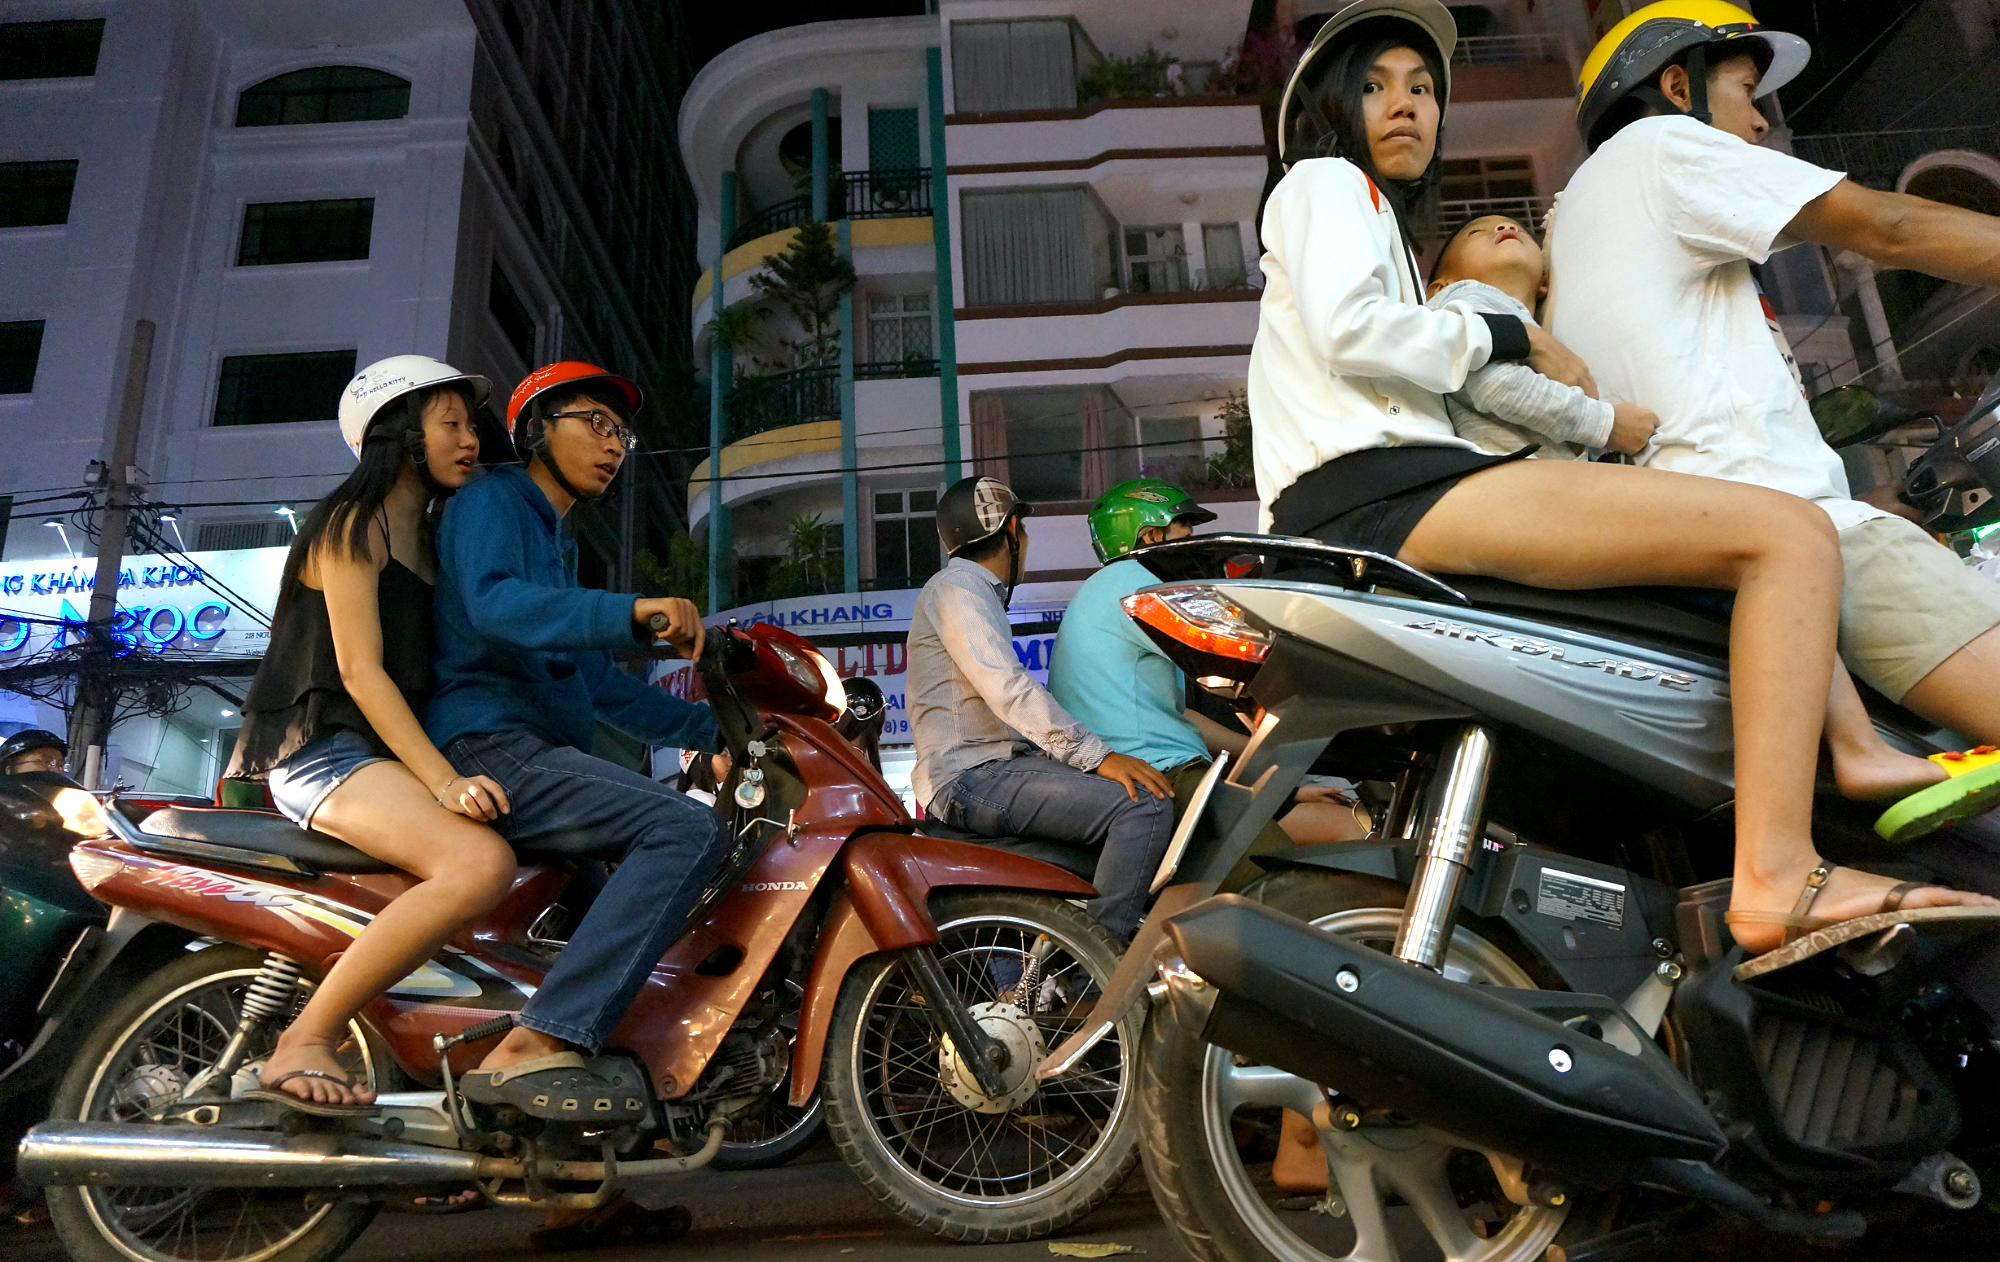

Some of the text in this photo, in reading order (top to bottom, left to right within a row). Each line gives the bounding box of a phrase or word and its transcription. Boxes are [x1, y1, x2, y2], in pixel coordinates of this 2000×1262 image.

[369, 376, 406, 394] HELLO KITTY
[142, 565, 204, 584] KHOA
[791, 603, 893, 626] KHANG
[1403, 619, 1698, 692] AIR BLADE
[741, 881, 809, 892] HONDA
